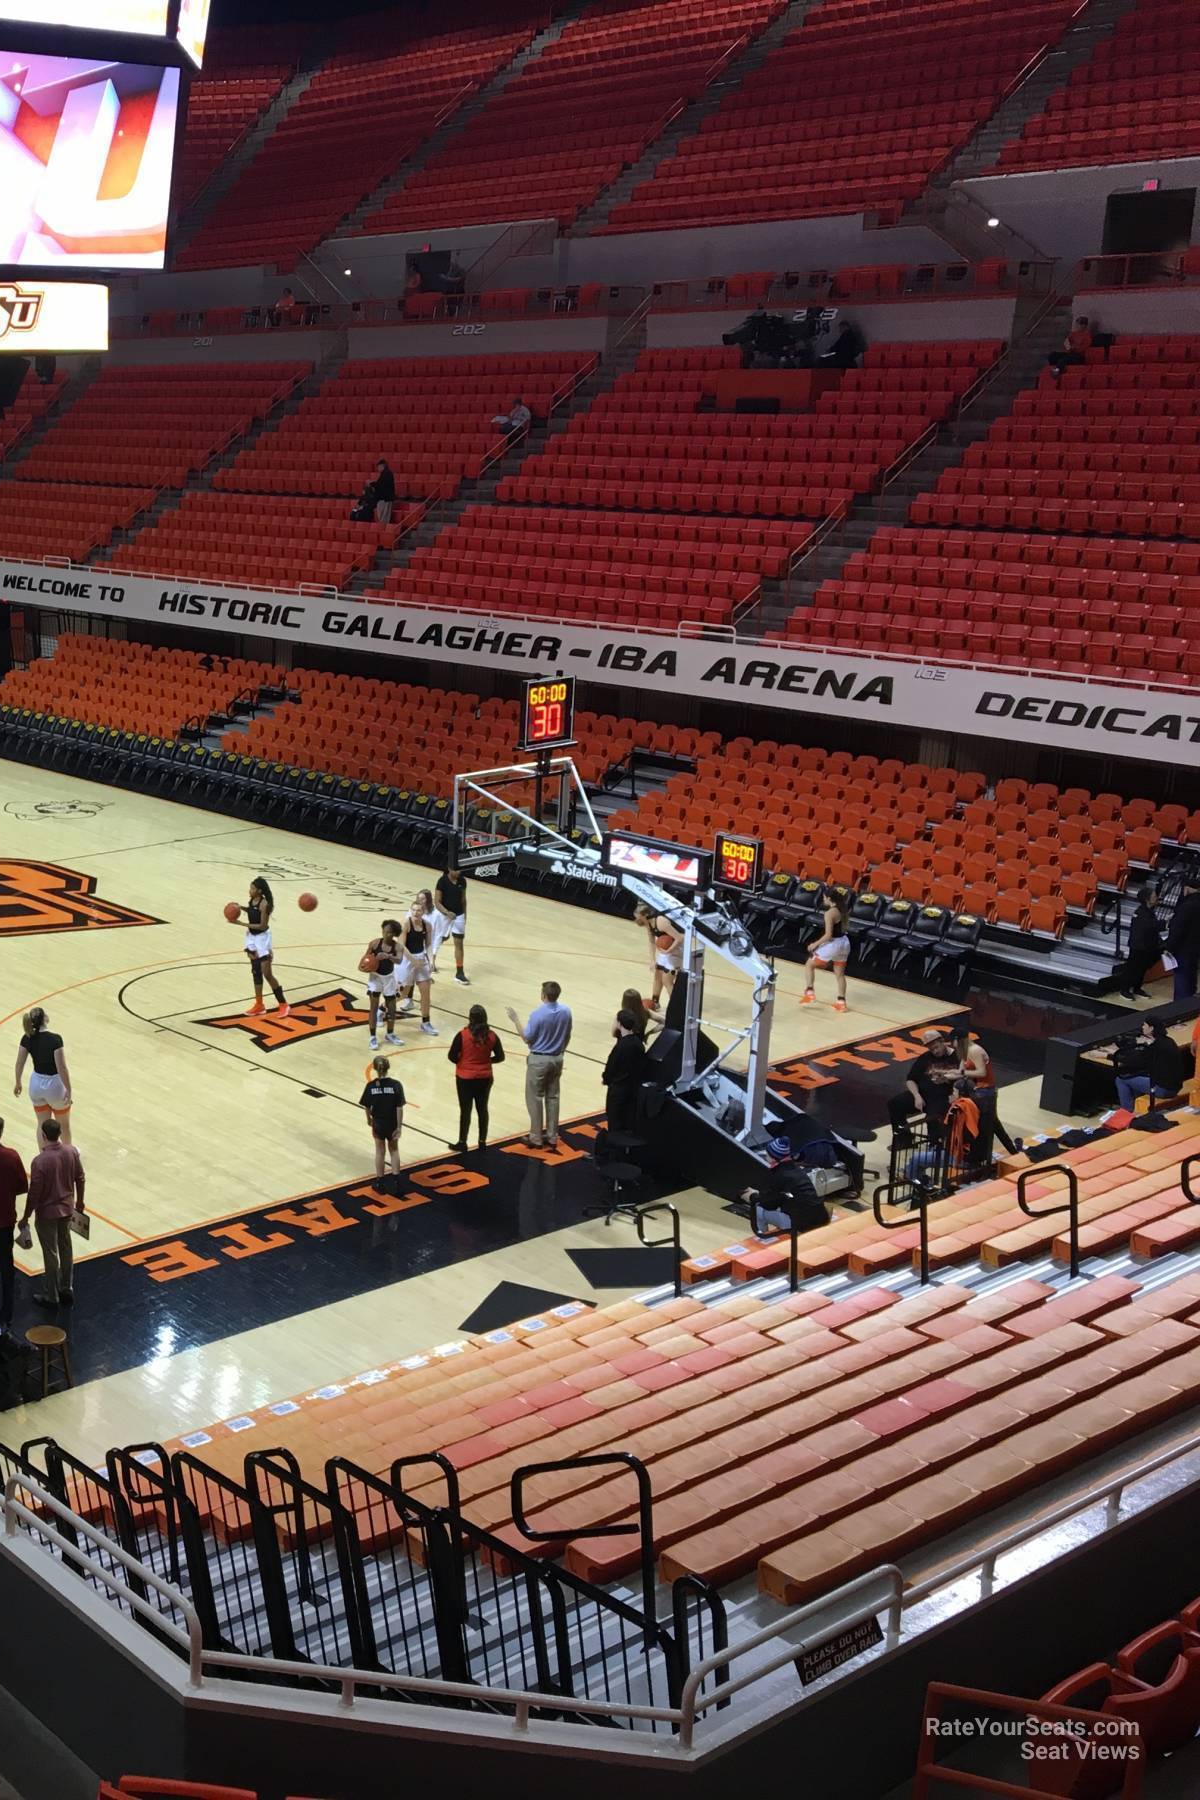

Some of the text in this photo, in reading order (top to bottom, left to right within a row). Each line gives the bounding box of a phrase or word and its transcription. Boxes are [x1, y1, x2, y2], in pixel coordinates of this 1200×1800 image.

[793, 308, 839, 321] 23
[452, 323, 486, 335] 202
[2, 574, 92, 599] WELCOME
[98, 585, 125, 602] TO
[158, 591, 305, 628] HISTORIC
[700, 656, 893, 706] ARENA
[530, 684, 566, 705] 60:00
[534, 704, 561, 738] 30
[722, 841, 754, 862] 60:00
[727, 859, 748, 880] 30
[119, 1162, 491, 1283] STATE
[803, 1644, 838, 1669] PLEASE
[805, 1631, 881, 1682] CLIMB OVER RAIL
